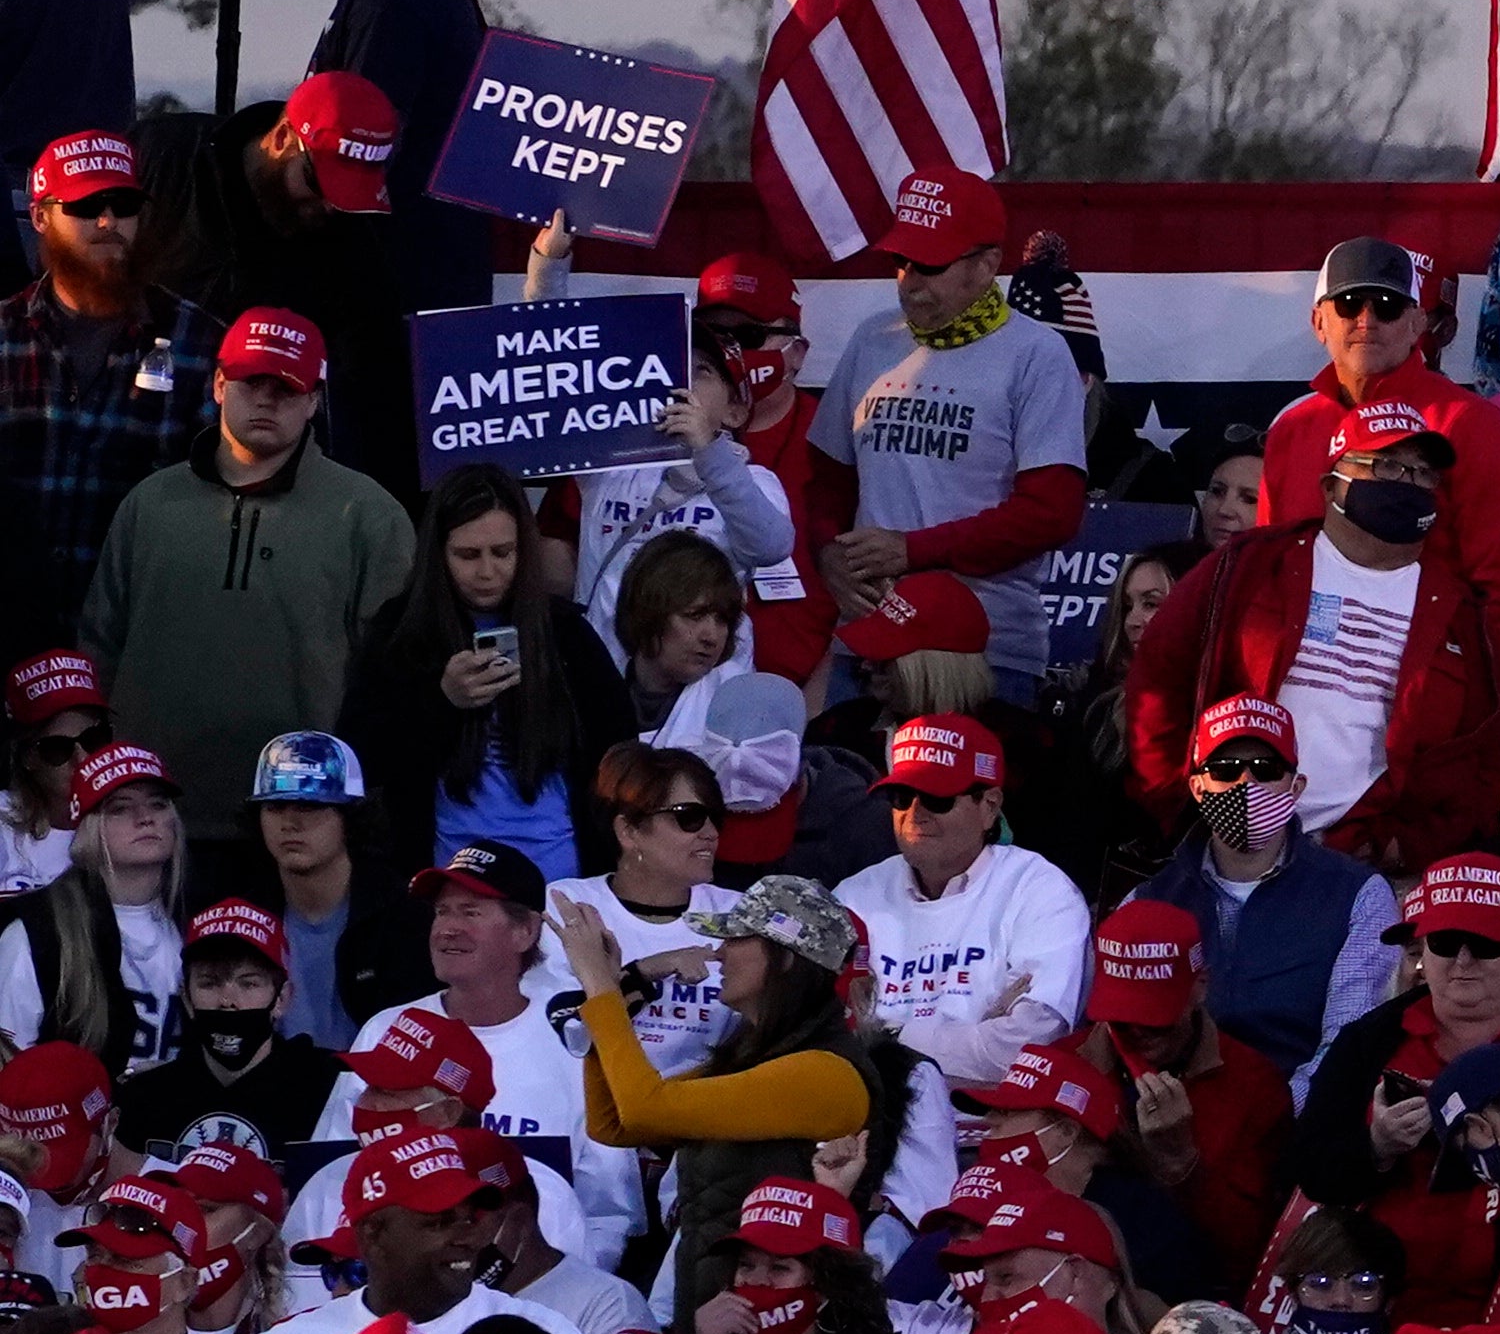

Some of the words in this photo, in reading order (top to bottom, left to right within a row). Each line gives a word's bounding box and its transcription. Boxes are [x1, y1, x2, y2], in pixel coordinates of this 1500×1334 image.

[471, 78, 687, 155] PROMISES
[511, 134, 626, 188] KEPT
[249, 322, 306, 344] TRUMP
[496, 325, 601, 358] MAKE
[429, 353, 674, 415] AMERICA
[431, 411, 547, 452] GREAT
[559, 396, 674, 437] AGAIN
[864, 398, 974, 430] VETERANS
[874, 425, 970, 460] TRUMP
[879, 948, 986, 980] TRUMP
[362, 1172, 386, 1201] 45
